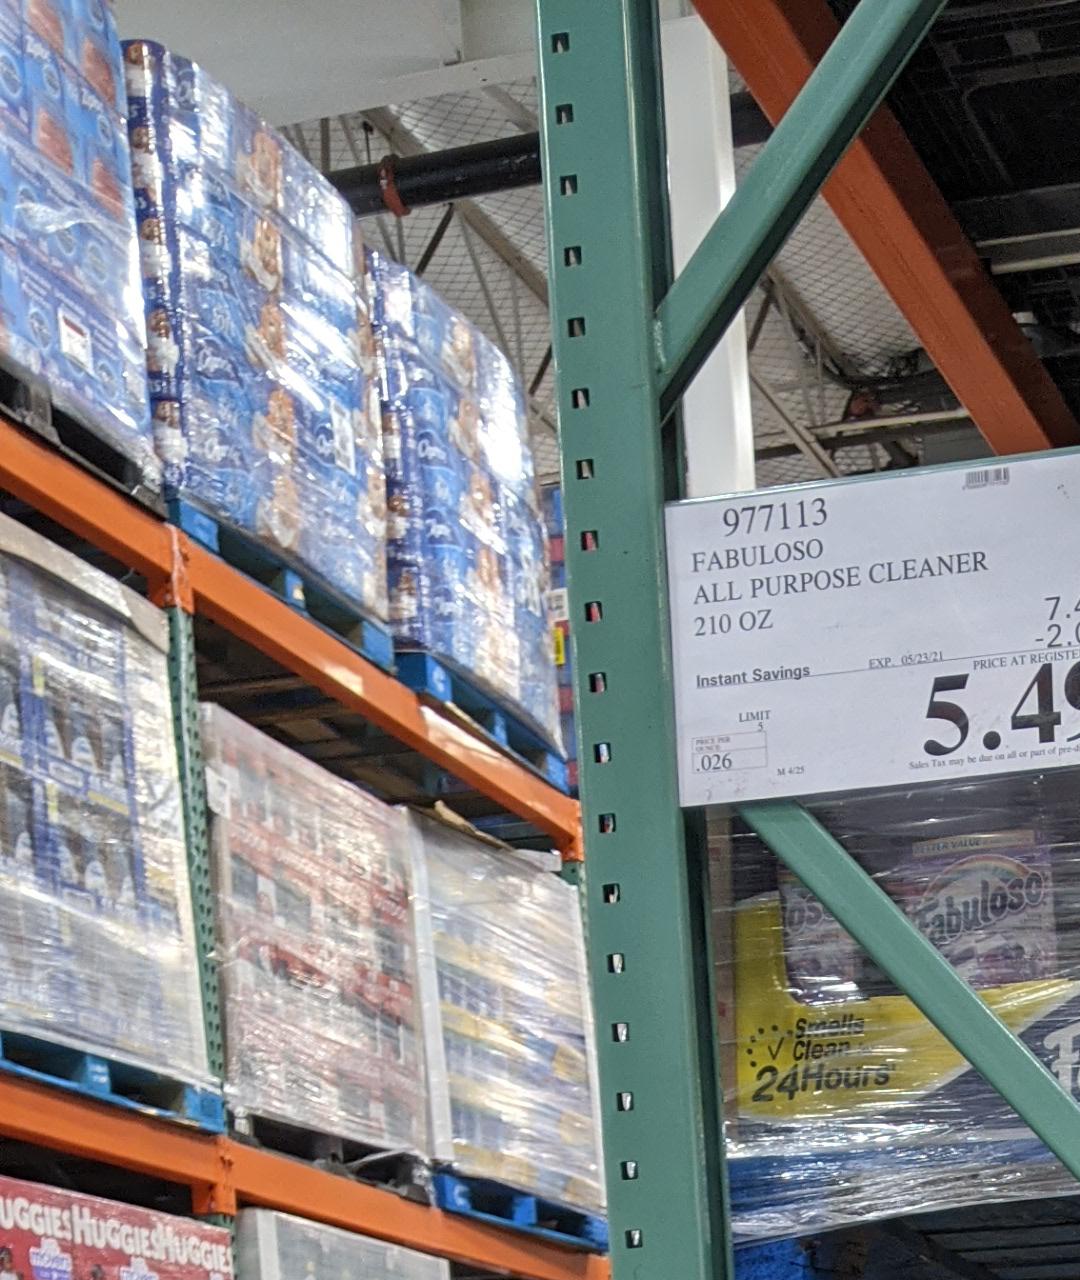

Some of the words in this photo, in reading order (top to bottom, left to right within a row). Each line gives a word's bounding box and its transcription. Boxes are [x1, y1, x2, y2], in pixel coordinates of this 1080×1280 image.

[723, 498, 828, 537] 977113
[691, 539, 824, 573] FABULOSO
[694, 584, 742, 605] ALL
[751, 566, 861, 598] PURPOSE
[869, 552, 990, 584] CLEANER
[695, 614, 732, 637] 210
[739, 609, 774, 632] OZ
[868, 658, 895, 669] EXP.
[901, 651, 944, 666] 05/23/21
[973, 657, 1007, 671] PRICE
[1010, 654, 1028, 667] AT
[696, 672, 747, 689] Instant
[752, 665, 811, 683] Savings
[738, 710, 771, 723] LIMIT
[696, 753, 733, 772] .026
[908, 760, 930, 769] Sales
[932, 758, 946, 767] Tax
[949, 757, 964, 767] may
[979, 752, 993, 761] due
[1030, 747, 1046, 759] part
[794, 1014, 865, 1040] Smells
[793, 1040, 851, 1062] Clean
[0, 1196, 72, 1240] UGGIES
[71, 1204, 165, 1261] HUGGIES
